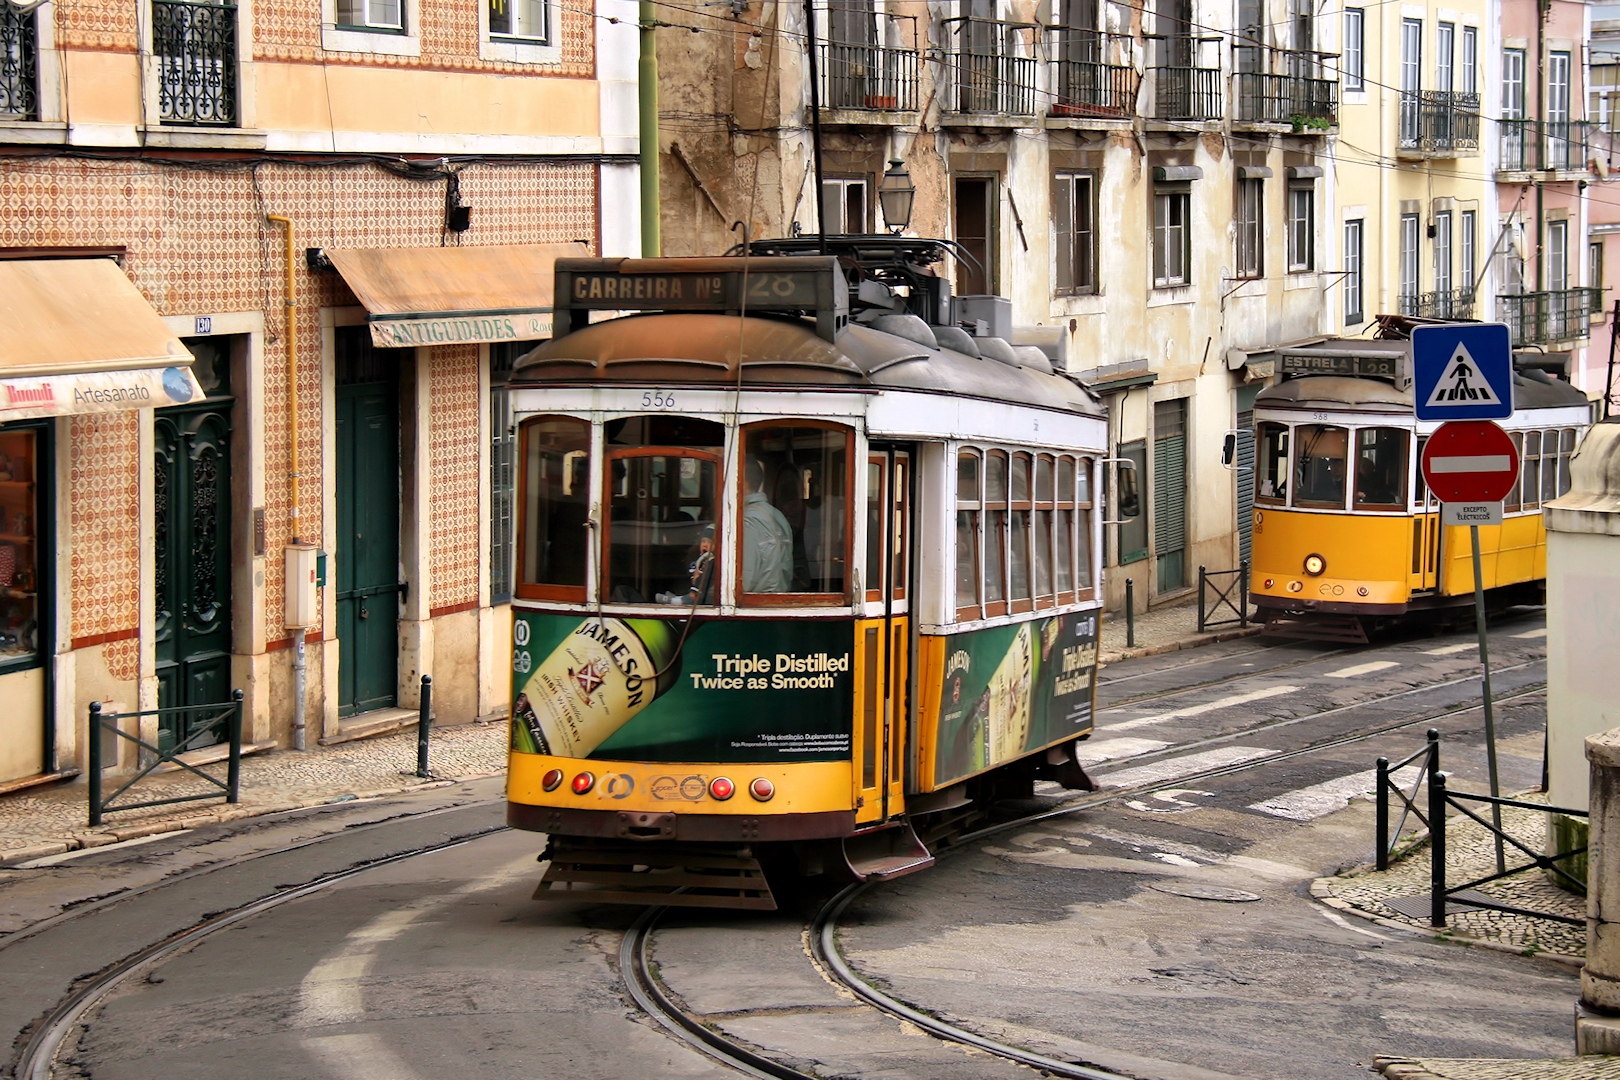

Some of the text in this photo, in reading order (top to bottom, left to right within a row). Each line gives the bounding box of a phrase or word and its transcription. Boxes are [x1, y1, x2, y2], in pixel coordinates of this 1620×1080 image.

[575, 272, 796, 299] CARREIRA Nº 28
[196, 318, 210, 333] 130
[391, 318, 517, 344] ANTIGUIDADES
[1285, 356, 1390, 374] ESTRELA 28
[6, 383, 54, 404] Buondi
[73, 384, 150, 405] Artesanato
[641, 391, 675, 408] 556
[1313, 412, 1328, 421] 568
[575, 622, 644, 709] JAMESON
[711, 652, 849, 677] Triple Distilled
[946, 649, 970, 680] JAMESON
[690, 673, 744, 689] Twice
[747, 677, 768, 690] as
[541, 673, 558, 695] IRISH
[557, 695, 582, 743] WHISKEY
